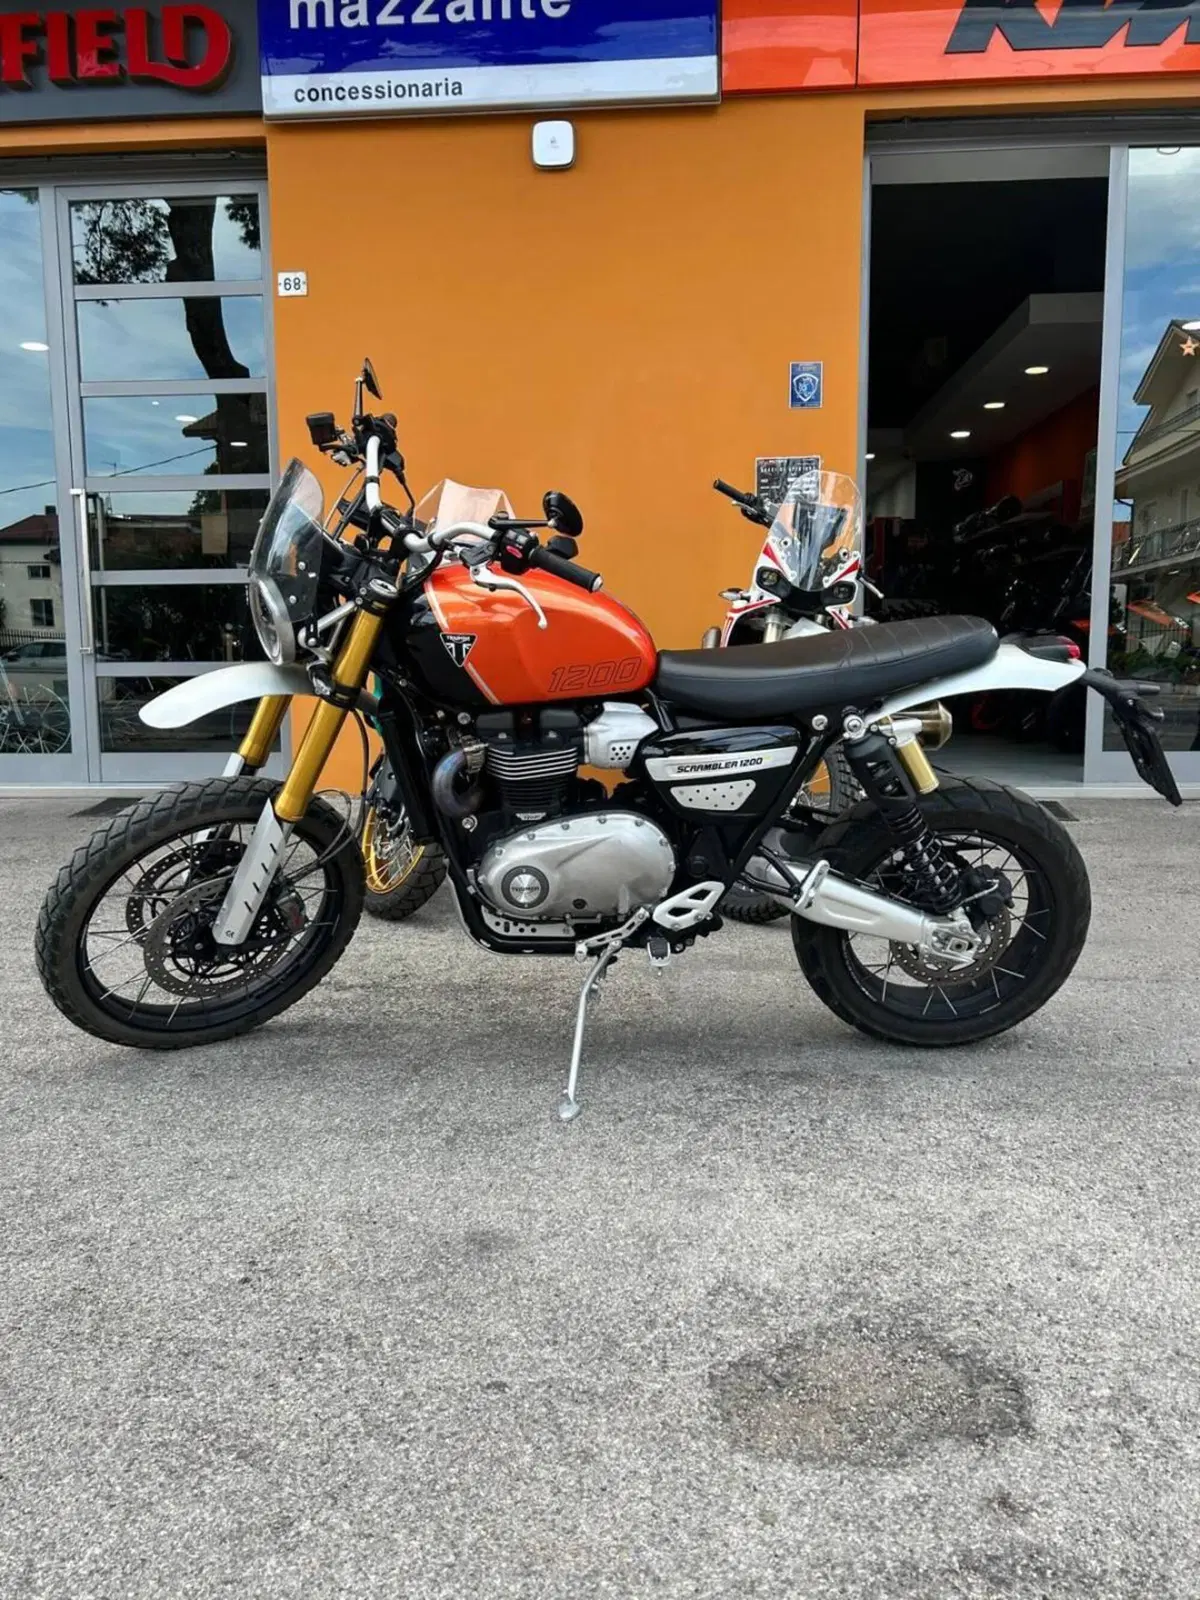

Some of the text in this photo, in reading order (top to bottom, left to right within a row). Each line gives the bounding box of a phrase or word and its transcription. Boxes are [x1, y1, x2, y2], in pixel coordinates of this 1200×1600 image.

[294, 78, 463, 102] concessionaria
[284, 277, 301, 291] 68
[548, 656, 642, 692] 1200
[676, 761, 740, 773] SCRAMBLER
[740, 757, 763, 768] 1200
